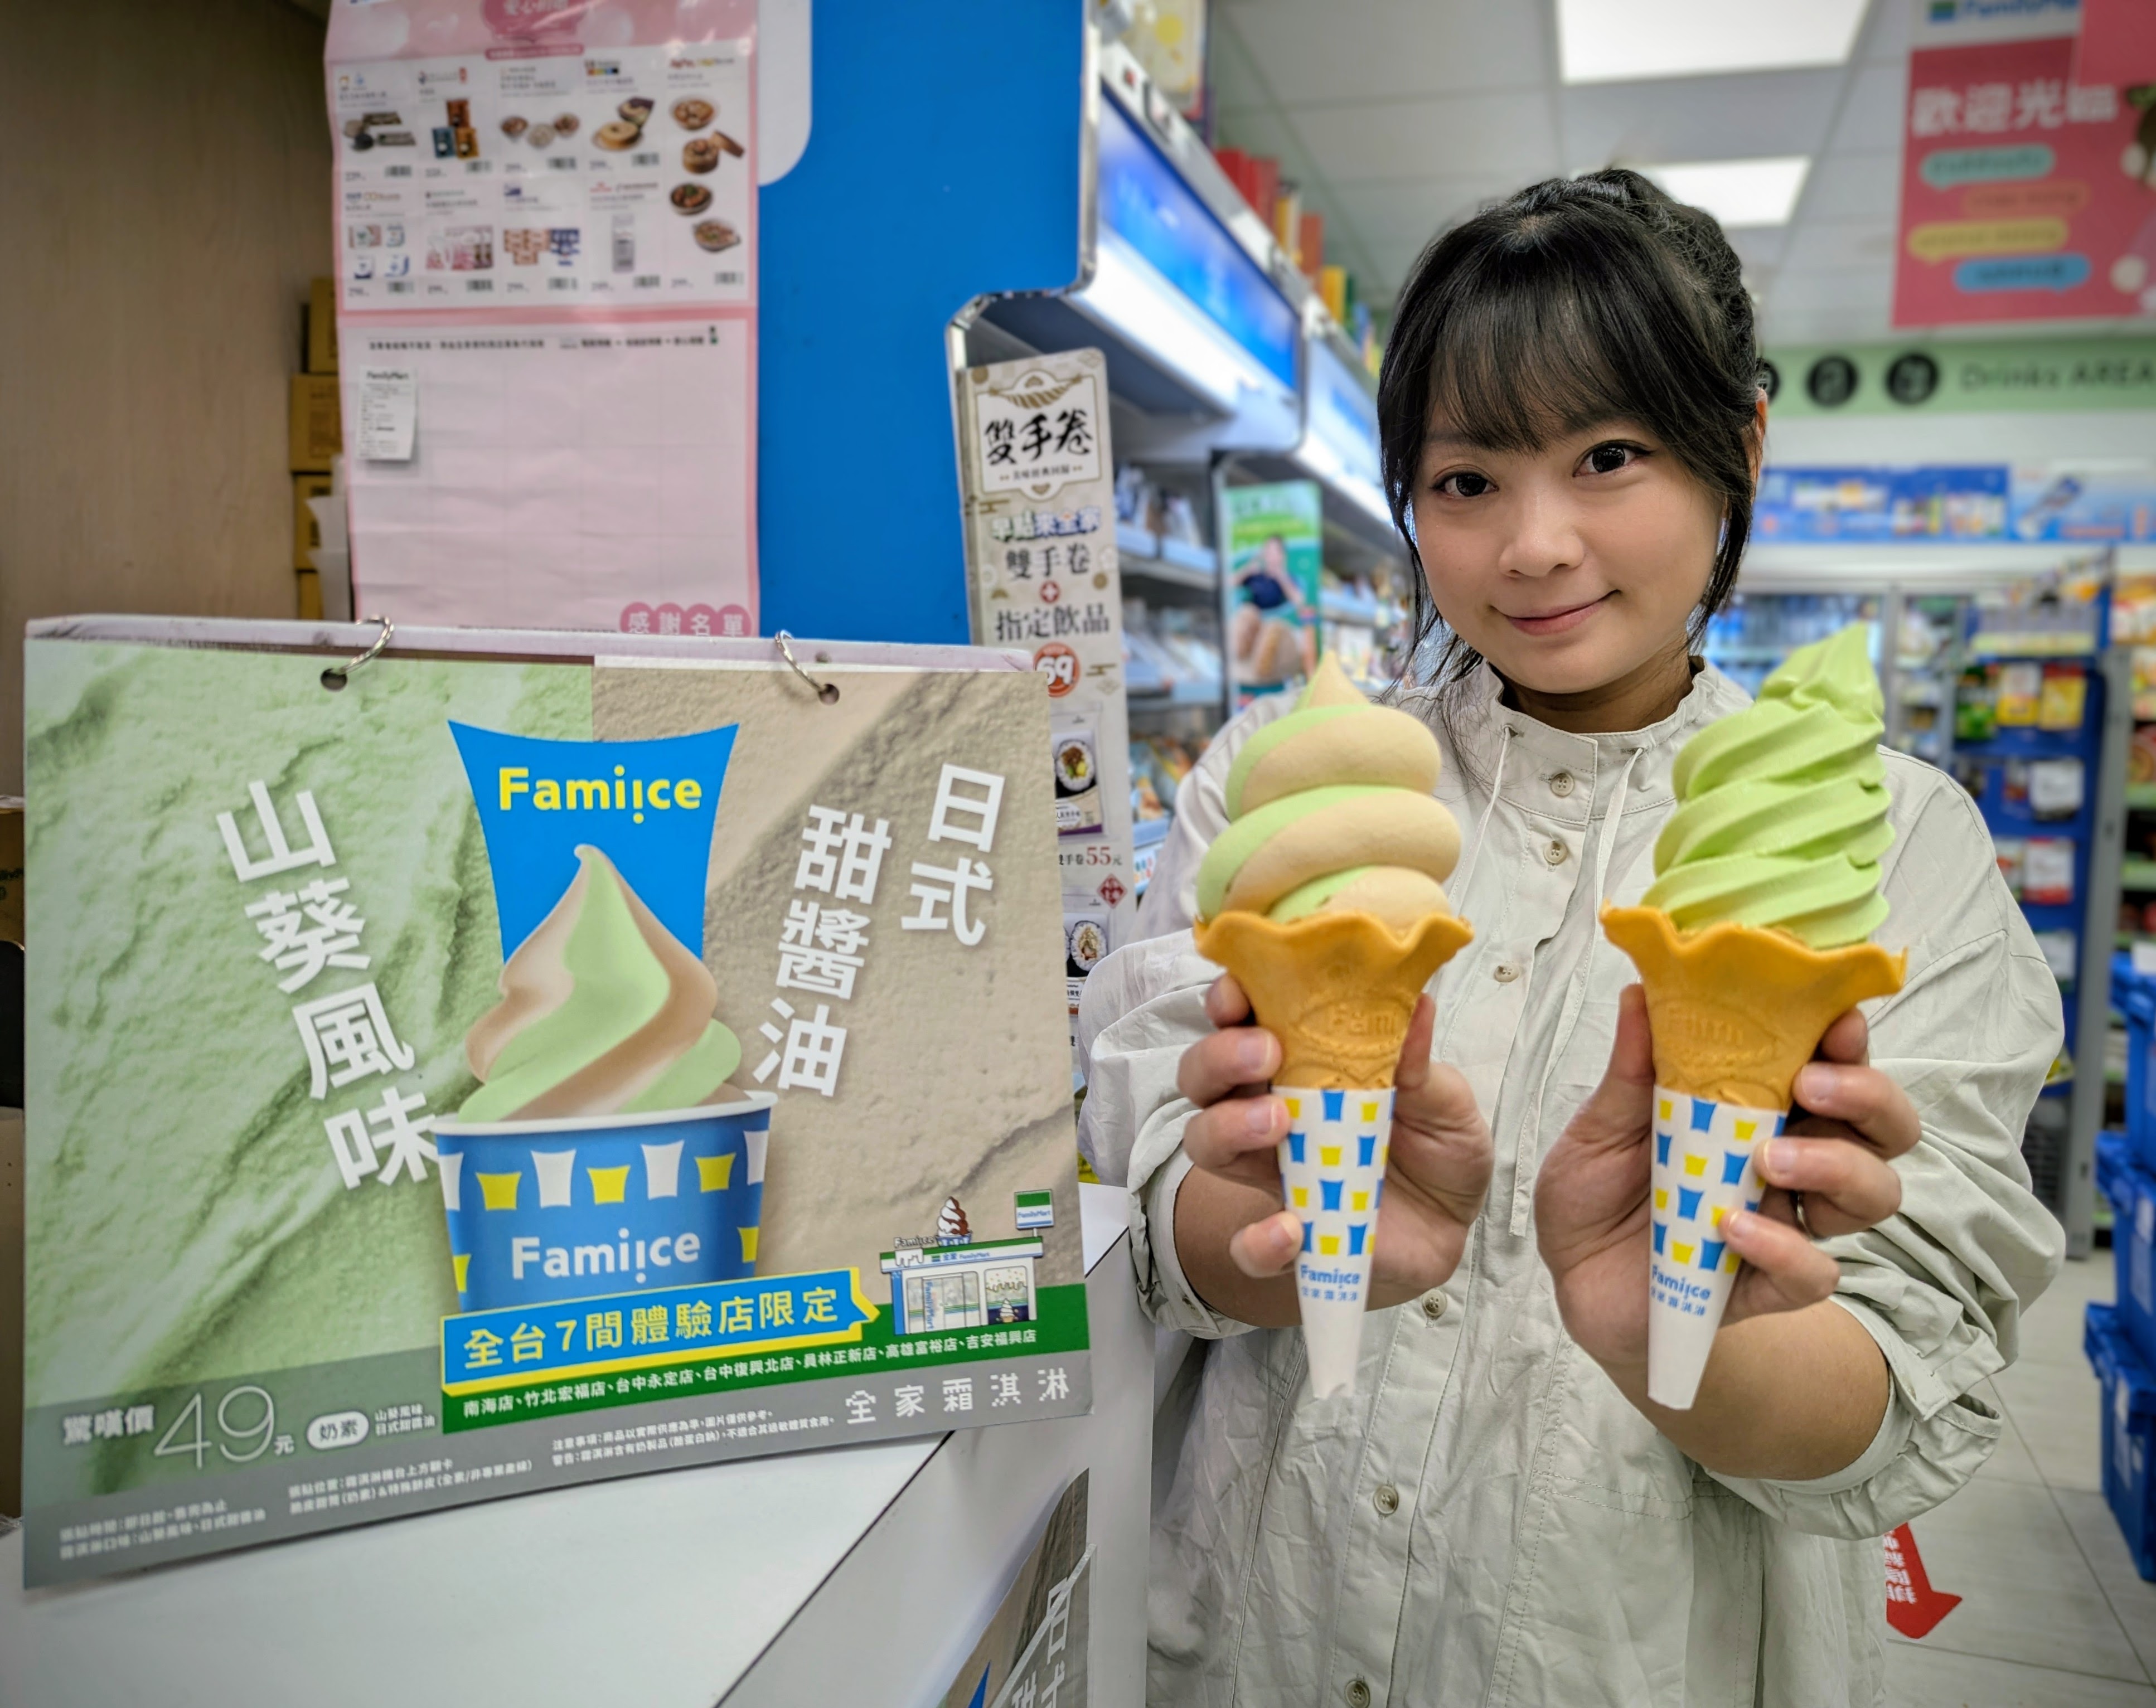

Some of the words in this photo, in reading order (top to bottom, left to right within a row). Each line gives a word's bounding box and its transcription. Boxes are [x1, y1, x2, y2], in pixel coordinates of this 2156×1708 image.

[985, 407, 1094, 466] 雙手卷
[1006, 543, 1091, 581] 雙手卷
[994, 602, 1111, 643] 指定飲品
[902, 763, 1006, 947] 日式
[753, 804, 893, 1097] 甜醬油
[216, 779, 439, 1190] 山葵風味
[463, 1285, 838, 1370] 全台7間體驗店限定
[845, 1367, 1070, 1425] 全家霜淇淋
[318, 1419, 360, 1440] 奶素
